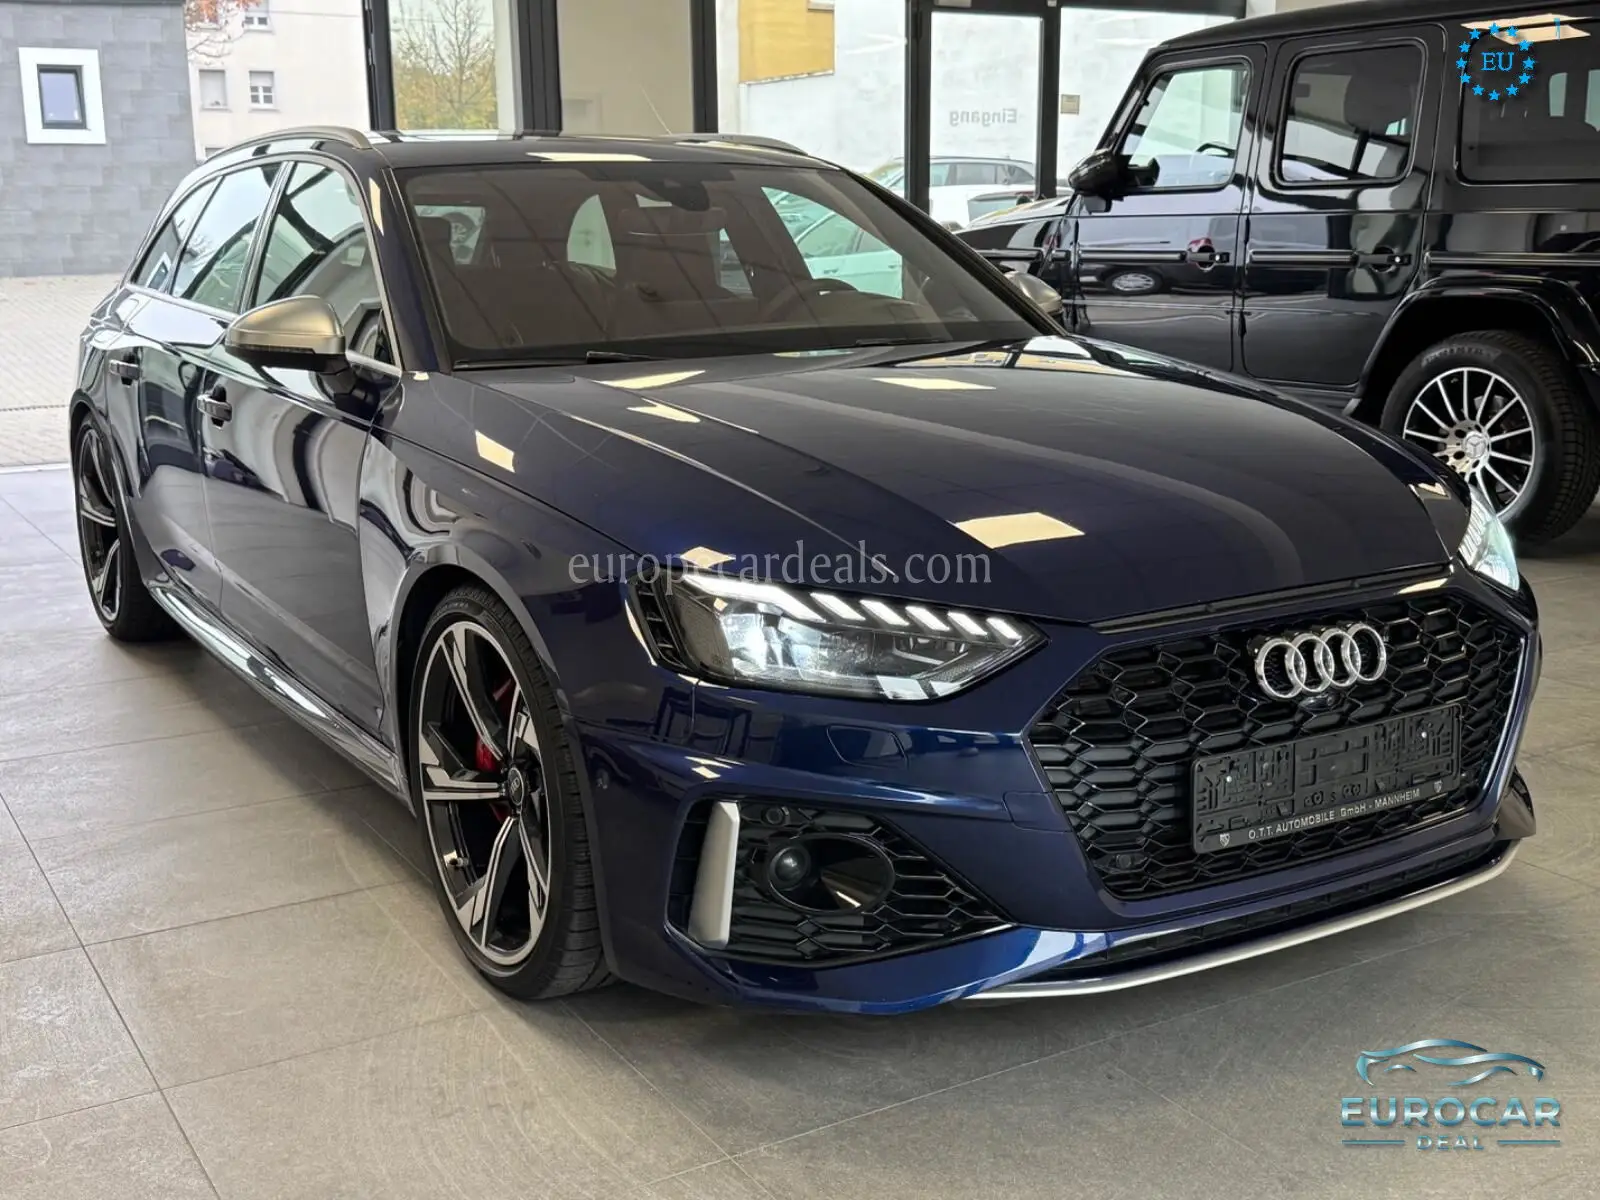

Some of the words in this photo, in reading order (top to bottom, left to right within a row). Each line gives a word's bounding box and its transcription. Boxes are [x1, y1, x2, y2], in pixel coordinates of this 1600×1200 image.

[1248, 825, 1273, 840] O.T.T.
[1276, 810, 1335, 833] AUTOMOBILE
[1340, 803, 1366, 817] GmbH
[1374, 788, 1420, 808] MANNHEIM
